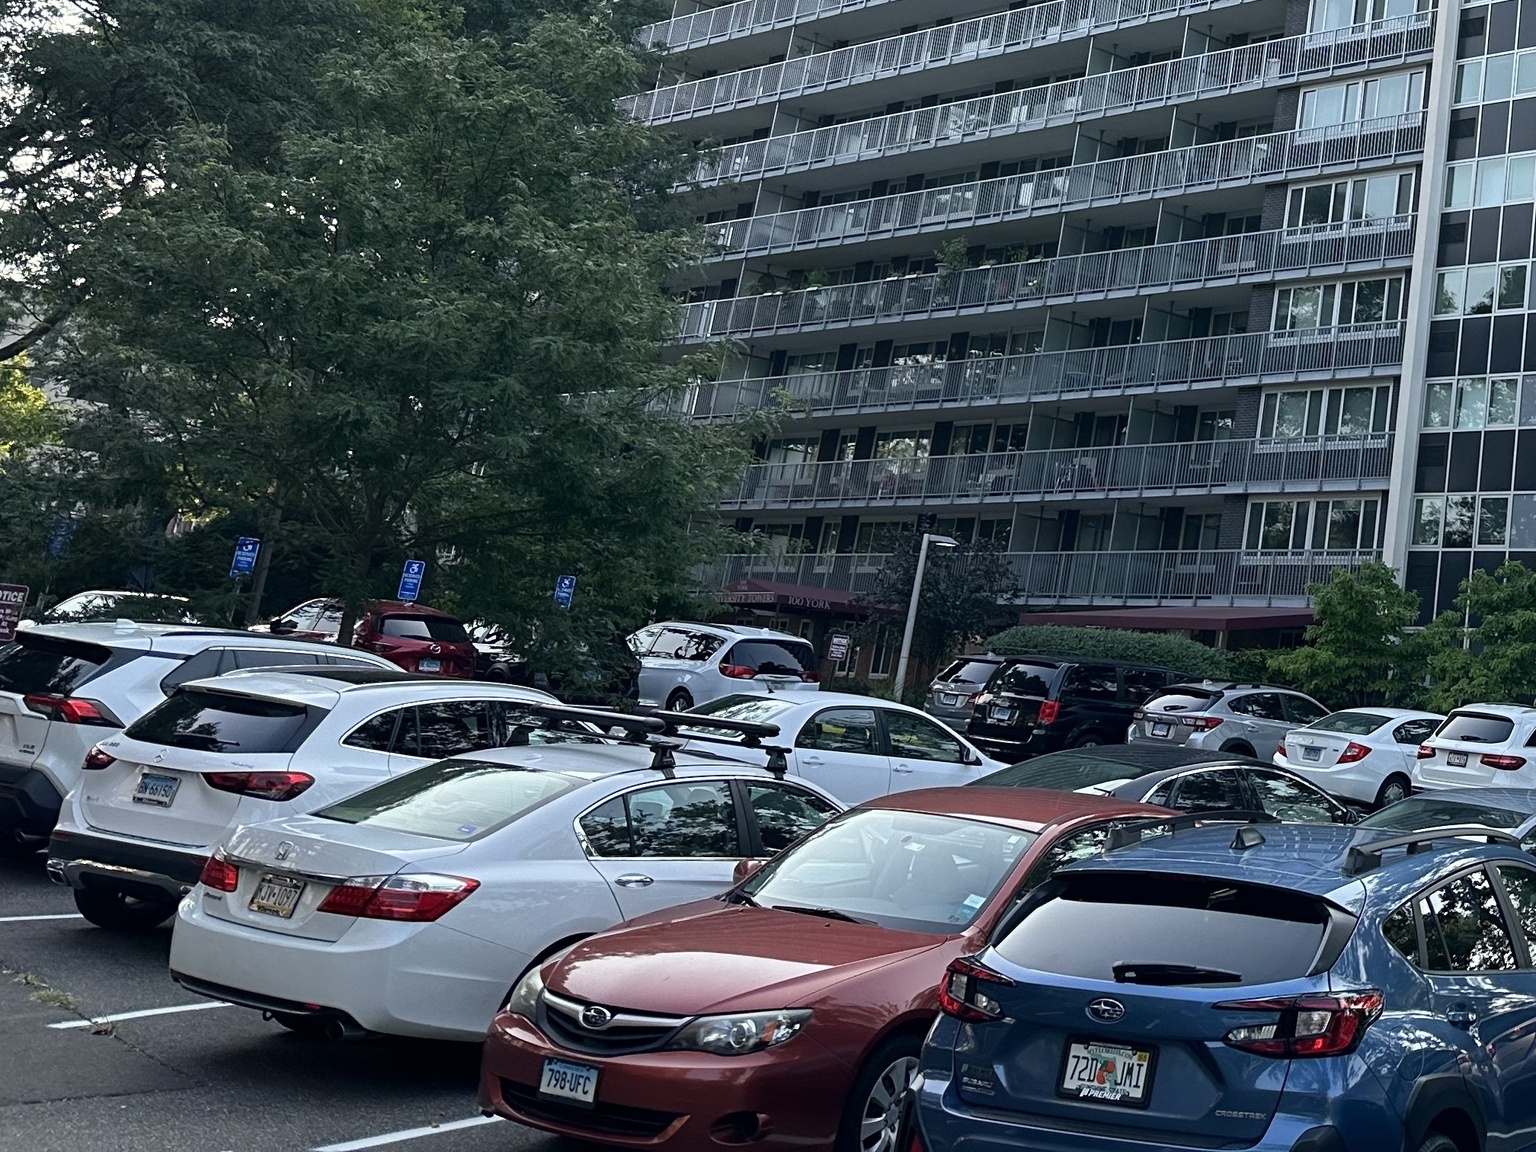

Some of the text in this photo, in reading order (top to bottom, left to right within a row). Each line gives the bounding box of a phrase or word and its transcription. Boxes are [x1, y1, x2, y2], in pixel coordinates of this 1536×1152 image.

[711, 594, 746, 603] NIVERSITY
[788, 595, 831, 610] 100 YORK
[1069, 1054, 1144, 1089] 72D JMI
[1087, 1089, 1122, 1101] PREMIER
[1215, 1109, 1267, 1120] CROSSTREK
